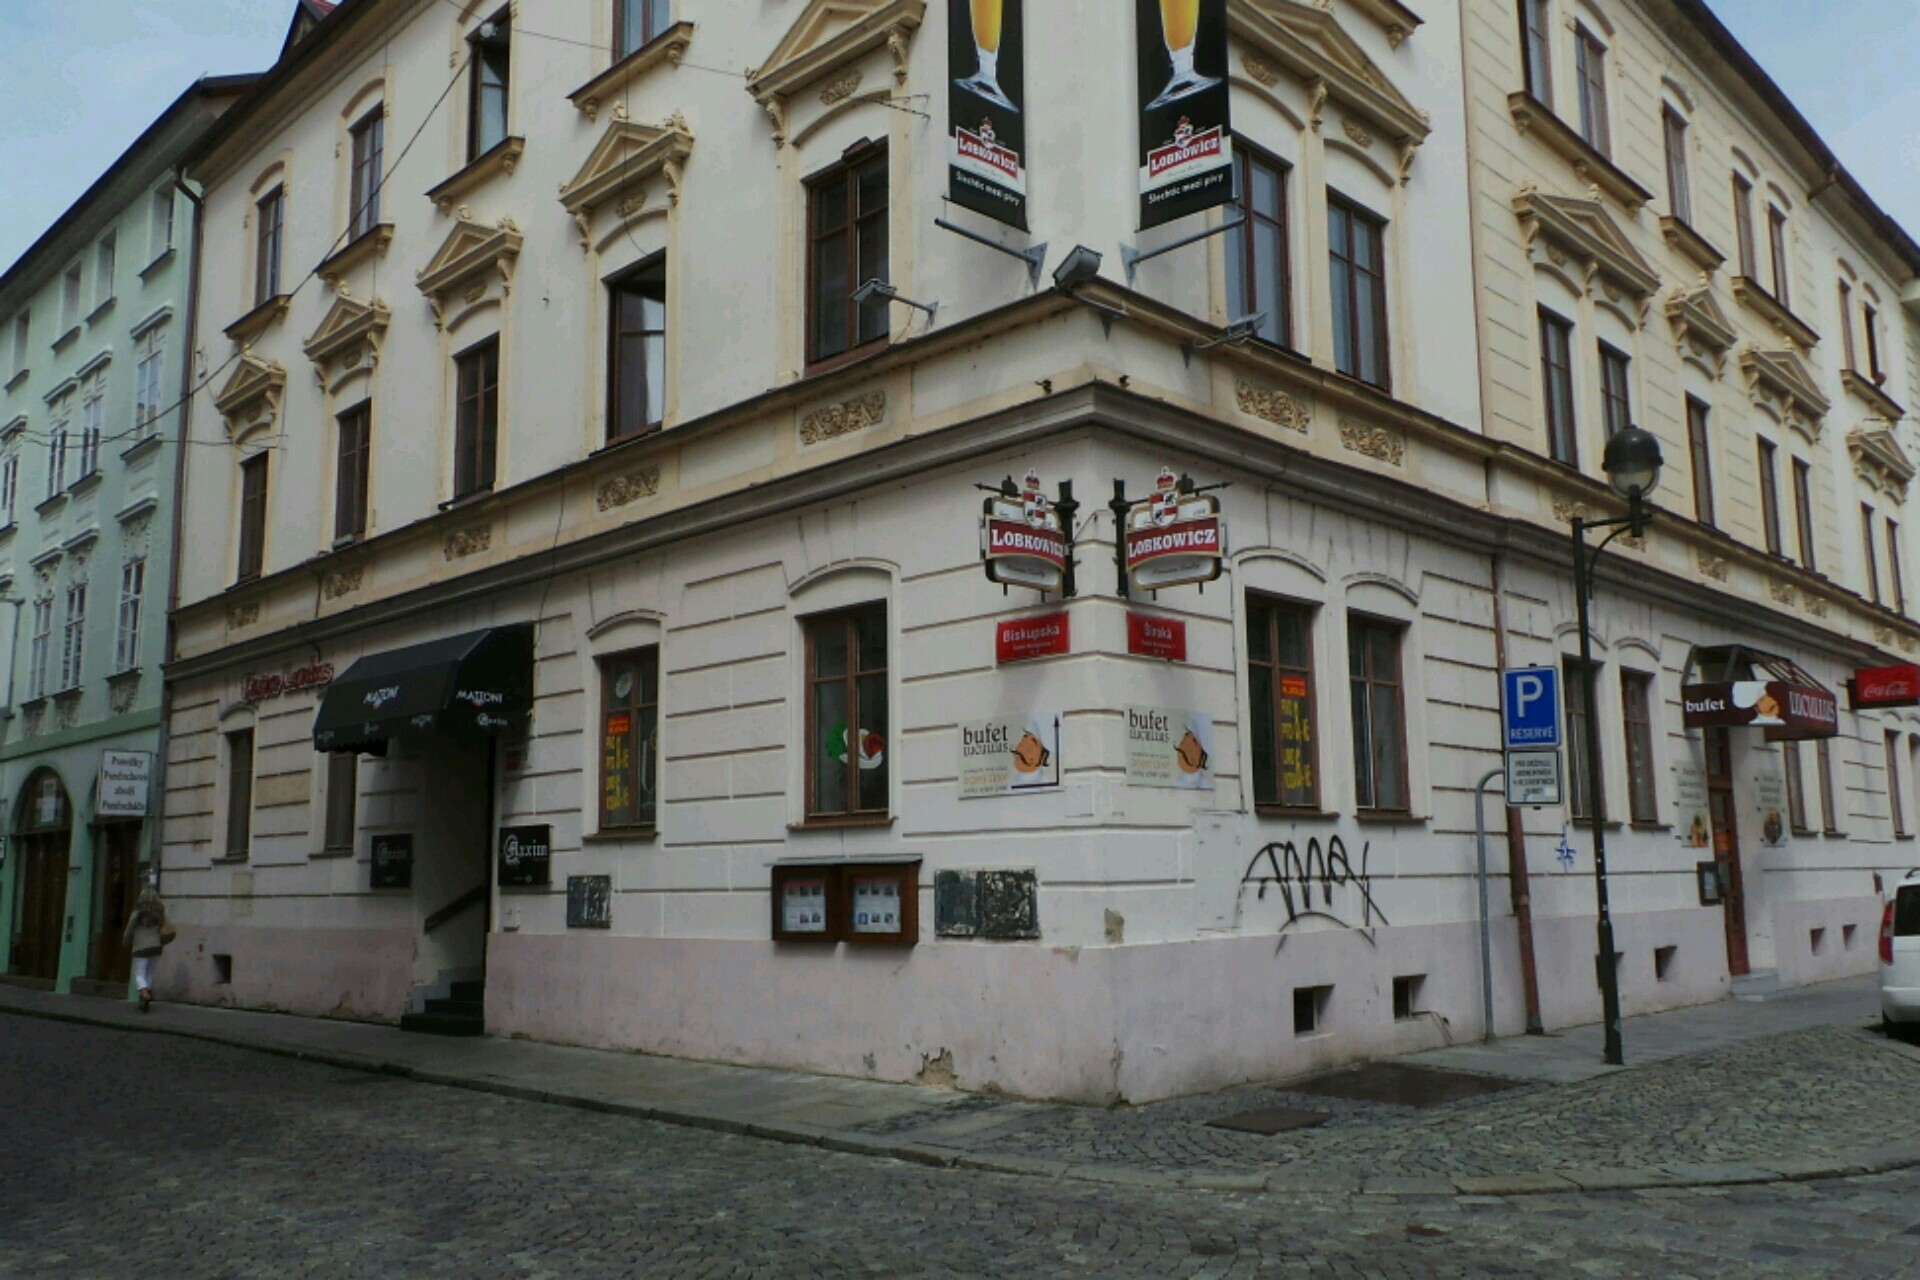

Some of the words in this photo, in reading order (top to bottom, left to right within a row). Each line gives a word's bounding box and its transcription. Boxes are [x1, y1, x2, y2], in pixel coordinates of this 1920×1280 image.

[1151, 137, 1218, 170] LOBKOWICZ
[992, 529, 1064, 557] LOBKOWICZ
[1128, 529, 1216, 558] LOBKOWICZ
[456, 690, 502, 704] MATTONI
[1516, 675, 1544, 718] P
[1685, 698, 1725, 712] bufet
[1129, 709, 1169, 731] bufet
[963, 722, 1008, 745] bufet
